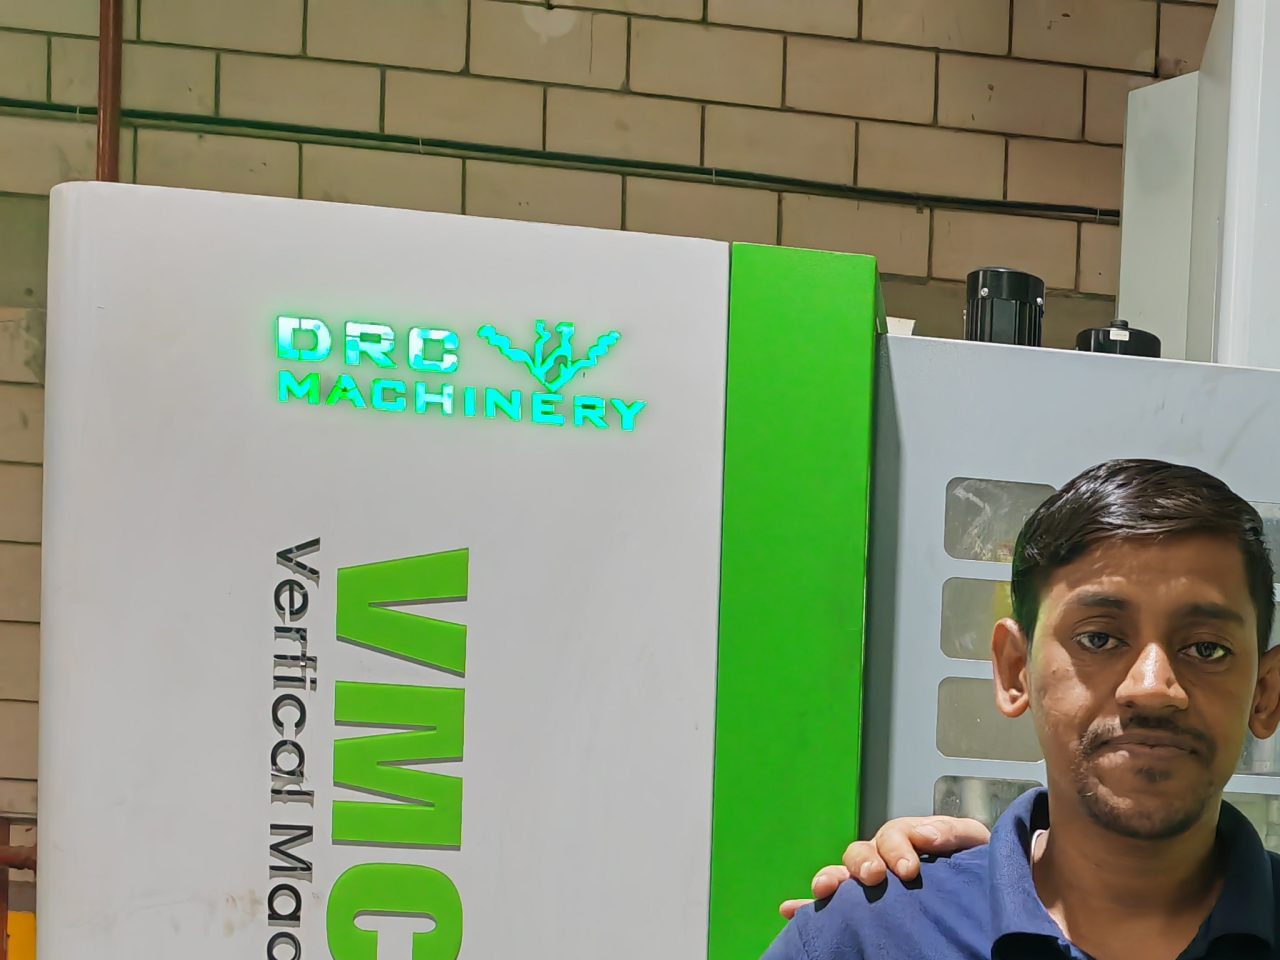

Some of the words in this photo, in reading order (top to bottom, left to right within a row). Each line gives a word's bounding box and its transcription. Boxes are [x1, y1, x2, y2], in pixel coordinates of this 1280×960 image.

[276, 315, 460, 374] DRC
[277, 369, 648, 432] MACHINERY
[270, 537, 321, 808] Vertical
